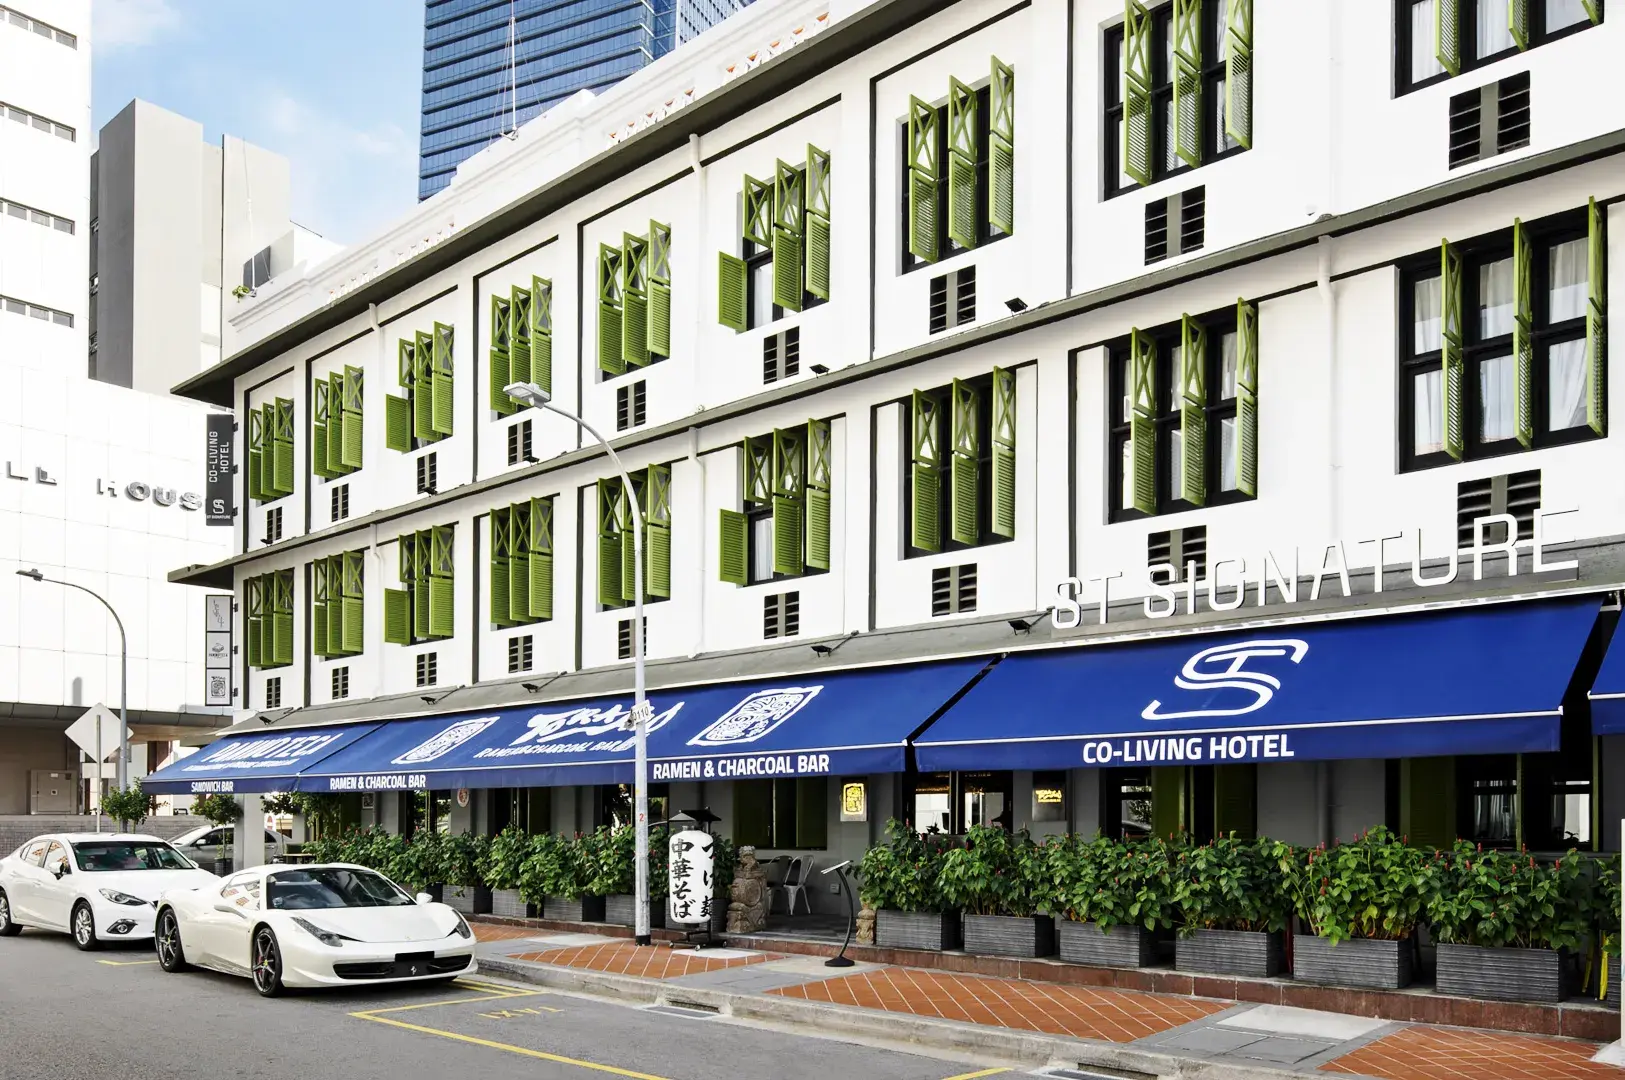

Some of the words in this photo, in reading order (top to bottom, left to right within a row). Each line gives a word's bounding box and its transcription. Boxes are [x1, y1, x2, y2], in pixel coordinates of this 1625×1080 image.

[208, 431, 219, 483] CO-LIVING
[220, 441, 230, 473] HOTEL
[1051, 570, 1123, 630] ST
[1144, 504, 1580, 619] SIGNATURE
[1082, 737, 1203, 764] CO-LIVING
[1209, 733, 1295, 760] HOTEL
[329, 776, 357, 791] RAMEN
[357, 775, 365, 789] &
[365, 775, 407, 789] CHARCOAL
[408, 774, 427, 788] BAR
[653, 760, 701, 780] RAMEN
[704, 760, 715, 778] &
[717, 755, 795, 777] CHARCOAL
[798, 754, 830, 773] BAR
[191, 781, 221, 793] SANDWICH
[221, 781, 234, 793] BAR
[671, 838, 697, 918] 中華そば
